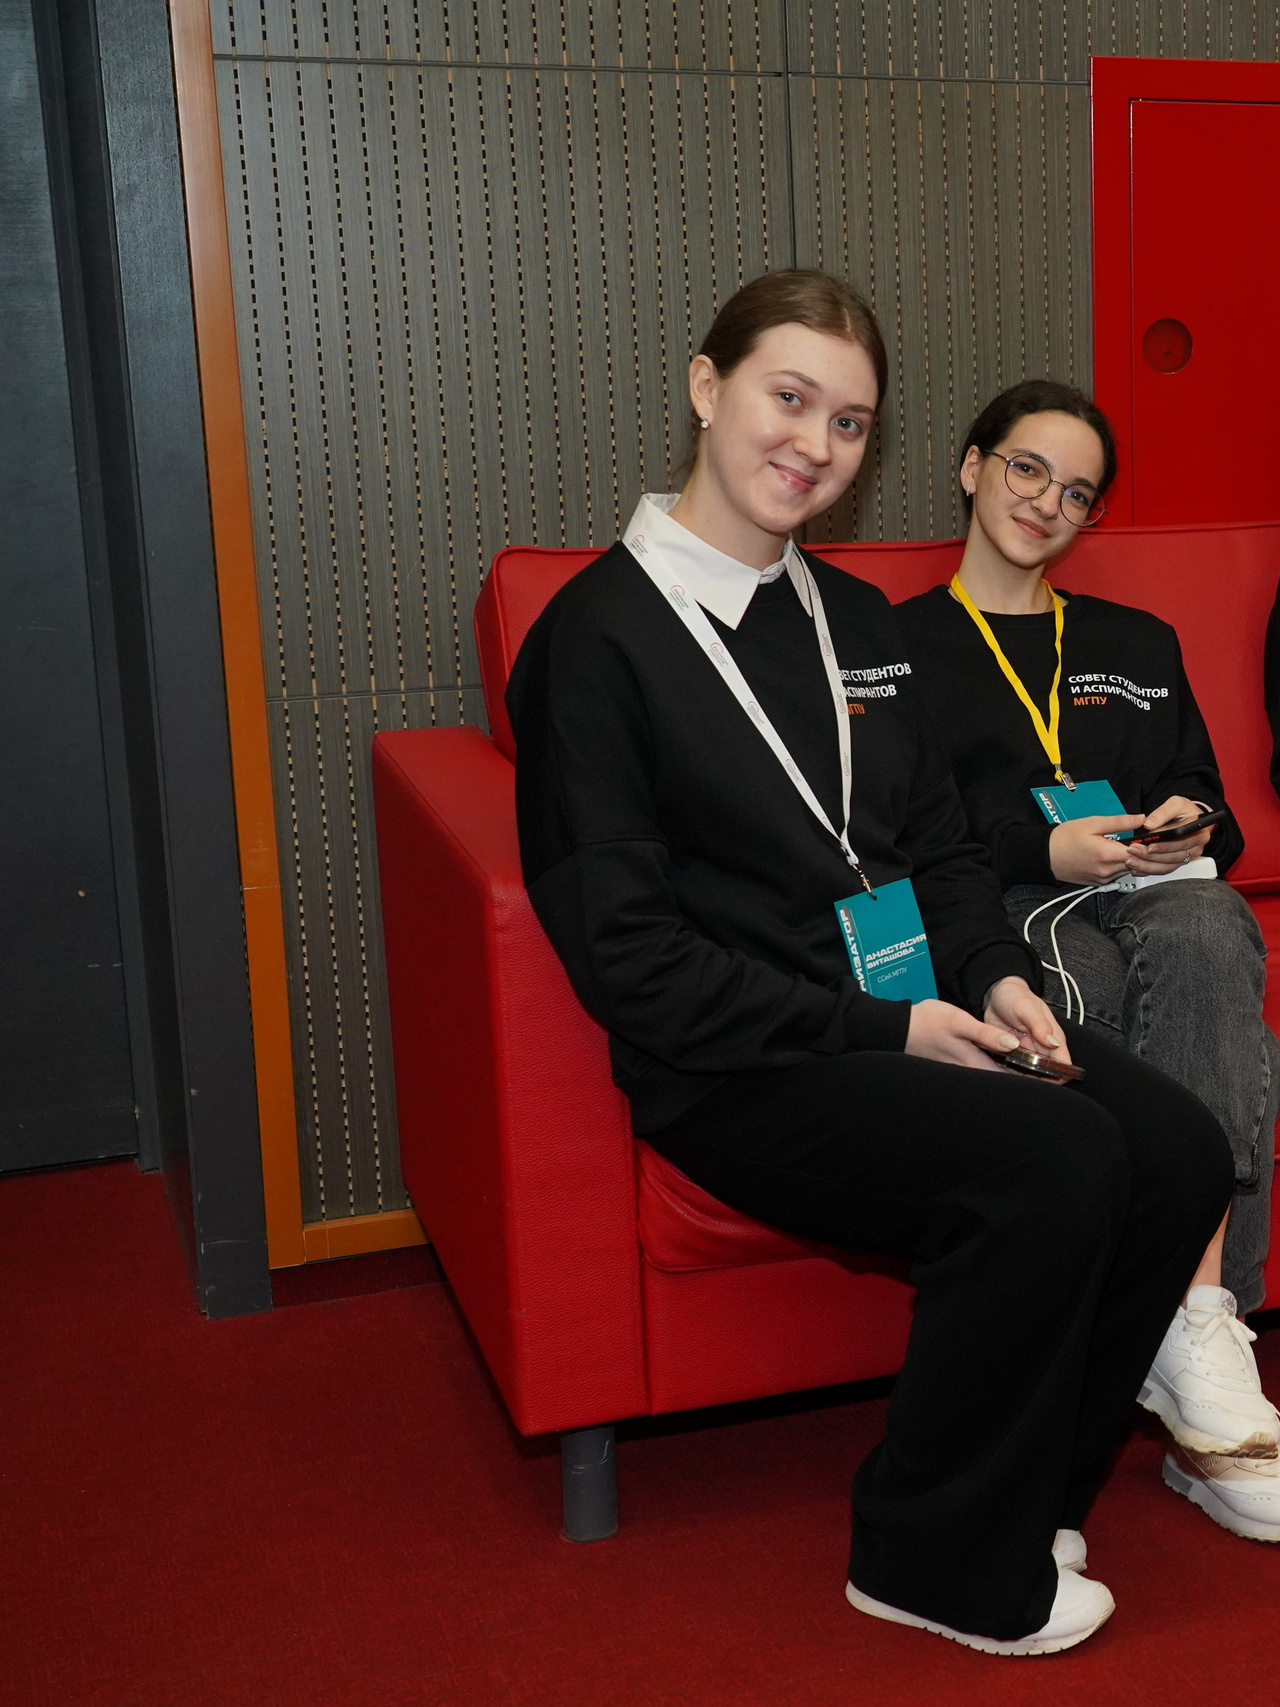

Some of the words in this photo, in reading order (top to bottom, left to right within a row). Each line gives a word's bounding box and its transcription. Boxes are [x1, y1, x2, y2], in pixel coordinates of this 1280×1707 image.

[851, 662, 912, 683] СТУДЕНТОВ
[1068, 674, 1107, 684] СОВЕТ
[1109, 674, 1169, 698] СТУДЕНТОВ
[1070, 685, 1080, 694] И
[1083, 684, 1151, 711] АСПИРАНТОВ
[1073, 696, 1107, 706] МГПУ
[840, 909, 868, 992] НИЗАТОР
[865, 933, 927, 963] АНАСТАСИЯ
[866, 946, 916, 970] ВИТАШОВА
